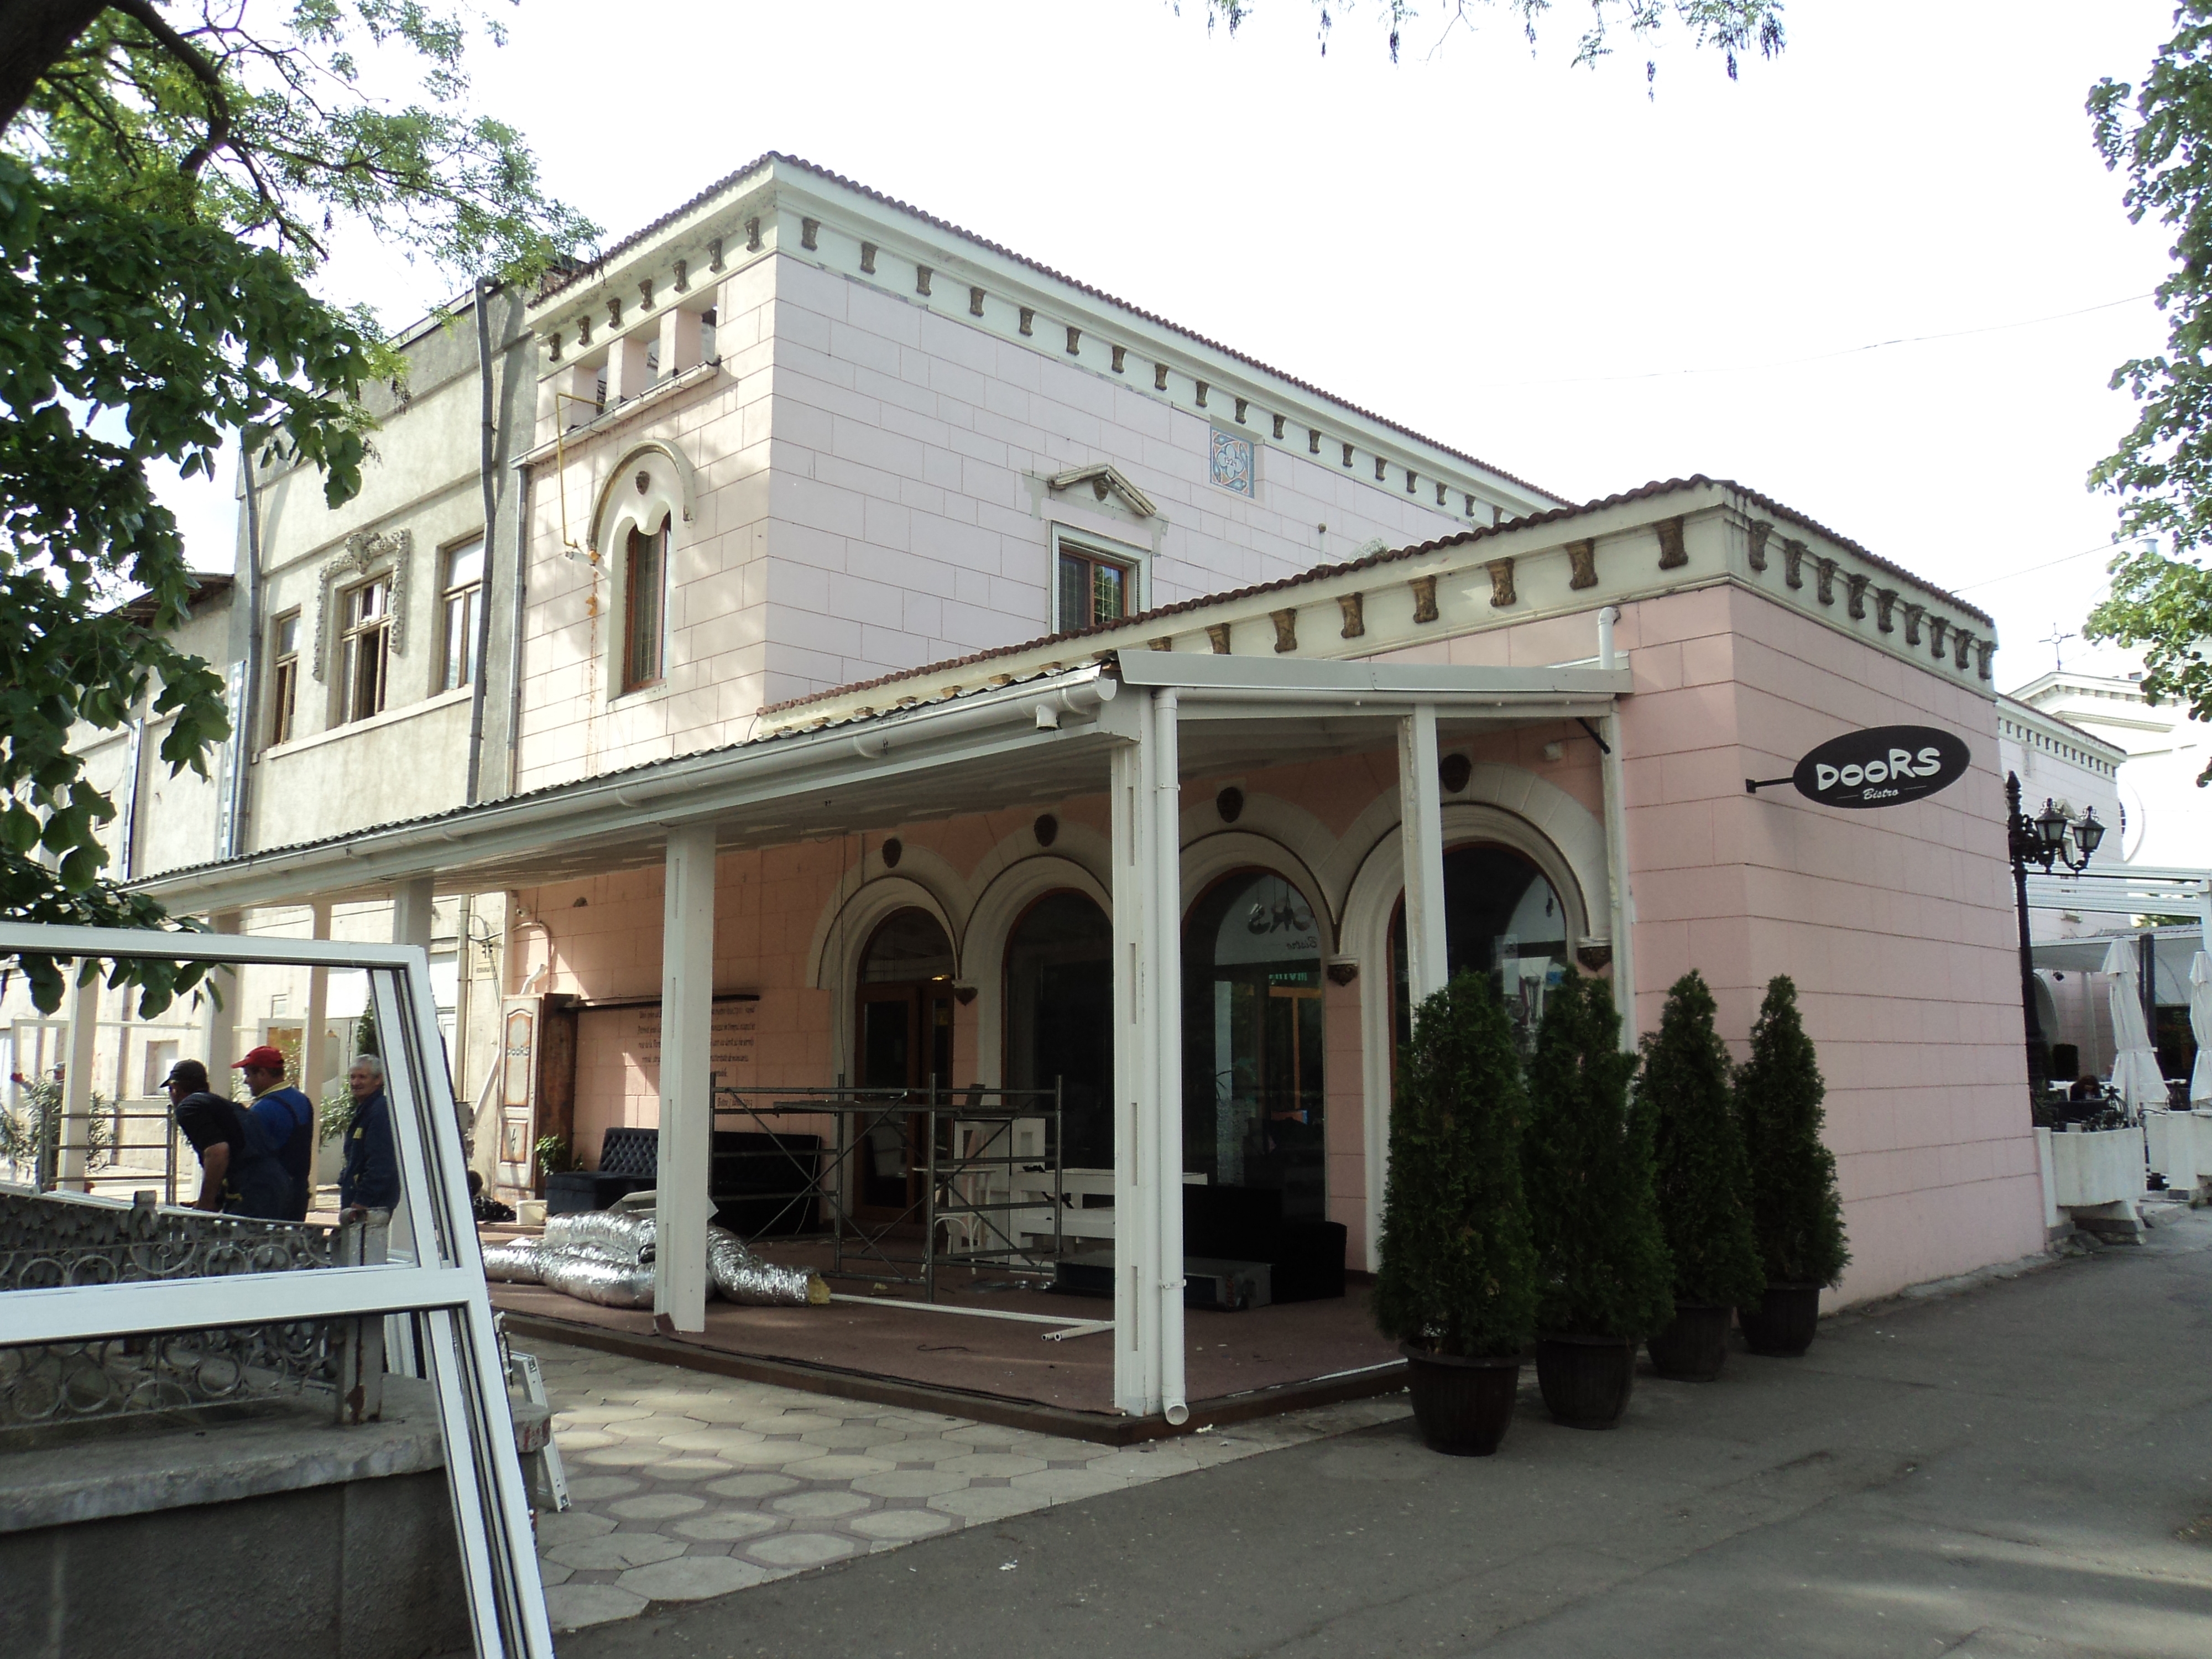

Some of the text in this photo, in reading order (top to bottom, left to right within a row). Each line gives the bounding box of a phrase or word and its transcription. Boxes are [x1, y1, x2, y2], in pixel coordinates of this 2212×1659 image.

[1224, 457, 1237, 467] 1924
[1815, 748, 1941, 791] DOORS
[1863, 788, 1899, 800] Bistro
